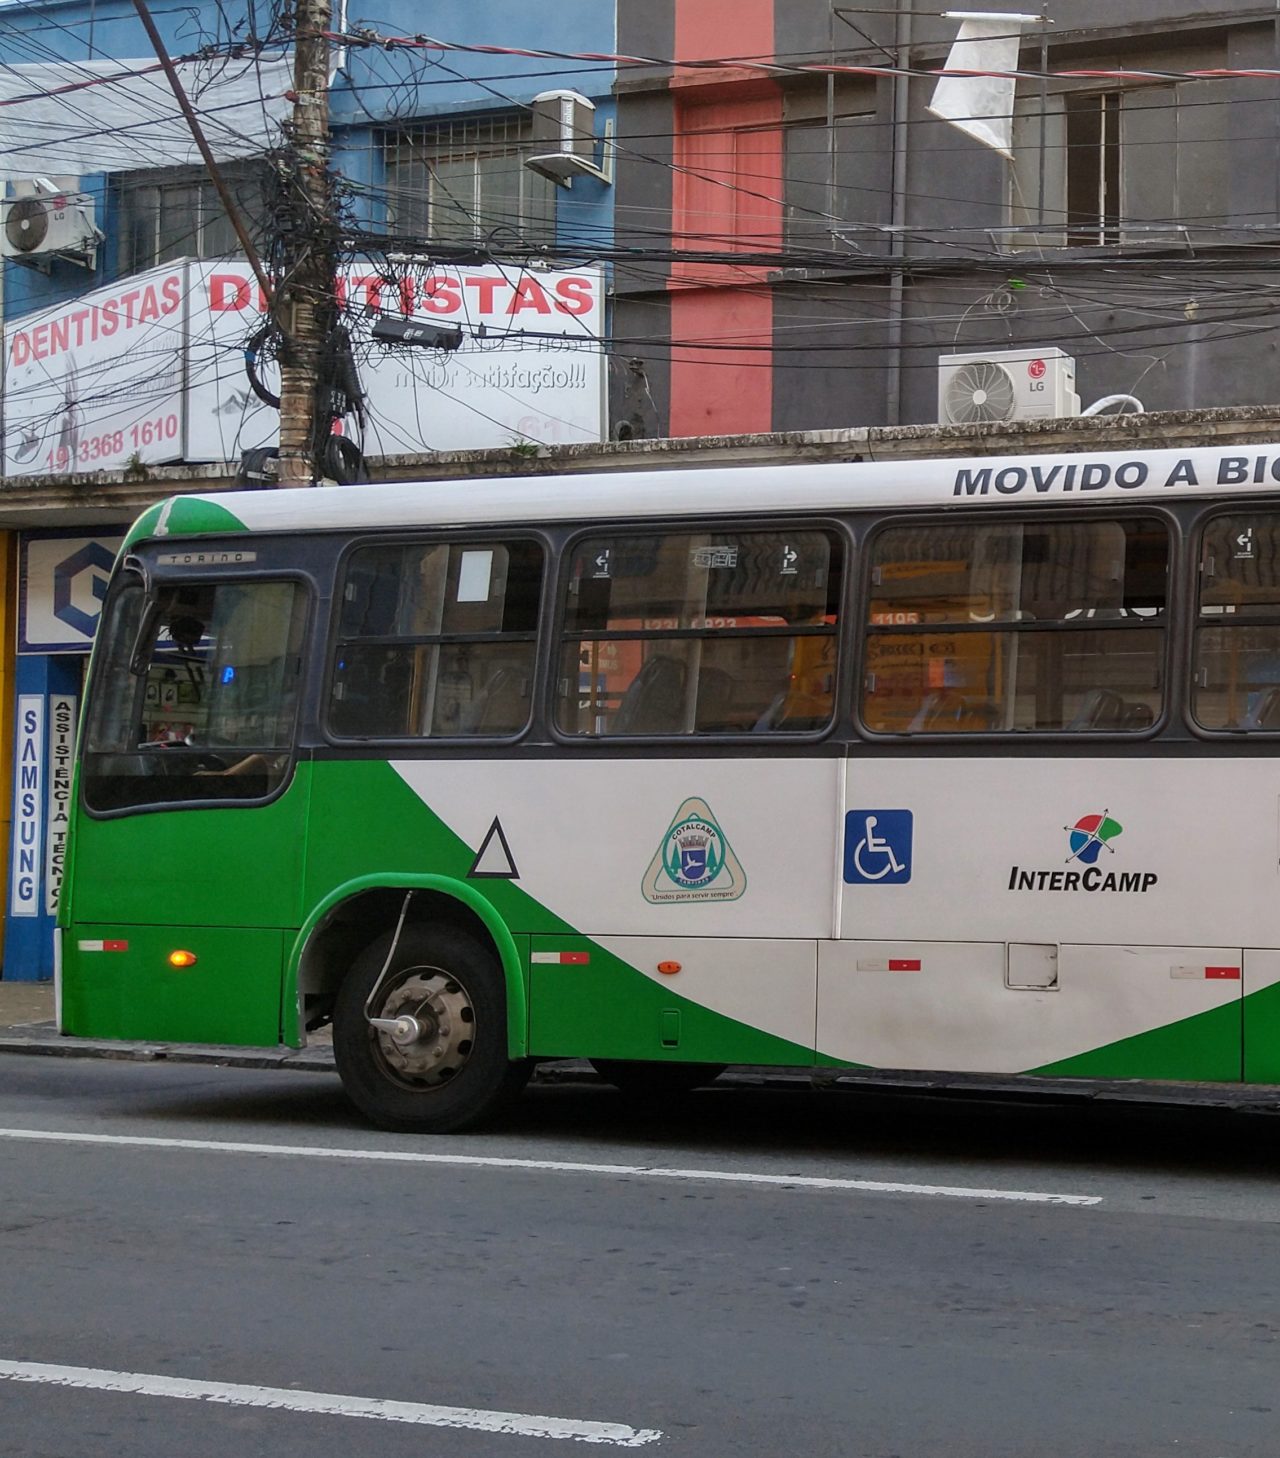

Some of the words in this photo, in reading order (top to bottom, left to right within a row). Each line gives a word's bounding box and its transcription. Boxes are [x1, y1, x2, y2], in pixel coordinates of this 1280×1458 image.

[210, 274, 594, 316] DTISTAS
[12, 276, 181, 367] DENTISTAS
[1029, 381, 1045, 392] LG
[46, 446, 69, 470] 19
[79, 430, 124, 463] 3368
[130, 414, 178, 448] 1610
[952, 460, 1150, 497] MOVIDO
[1164, 458, 1199, 489] A
[170, 552, 244, 564] TORINO
[18, 709, 38, 902] SAMSUNG
[672, 823, 717, 841] COTALCAMP
[1008, 866, 1159, 893] INTERCAMP
[675, 893, 691, 901] para
